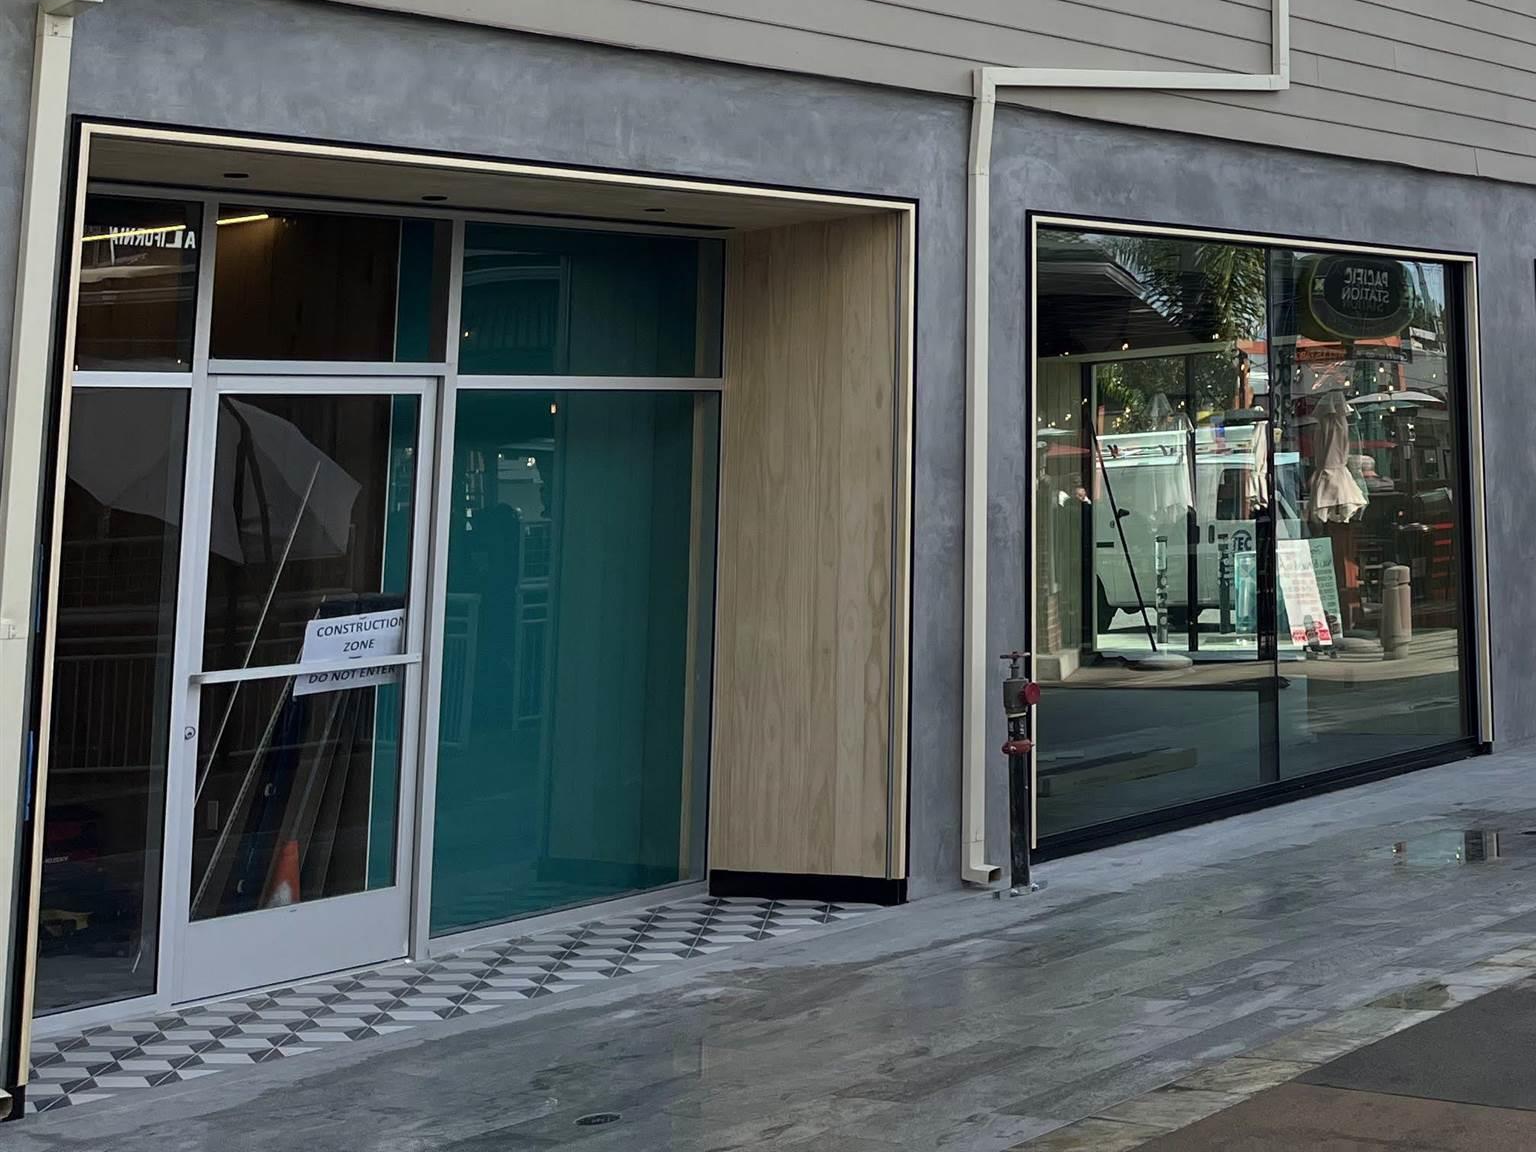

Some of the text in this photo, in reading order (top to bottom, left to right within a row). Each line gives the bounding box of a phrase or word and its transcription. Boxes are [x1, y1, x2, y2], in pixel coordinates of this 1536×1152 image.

[317, 616, 405, 638] CONSTRUCTION
[343, 639, 375, 652] ZONE
[308, 665, 396, 684] DO NOT ENTER
